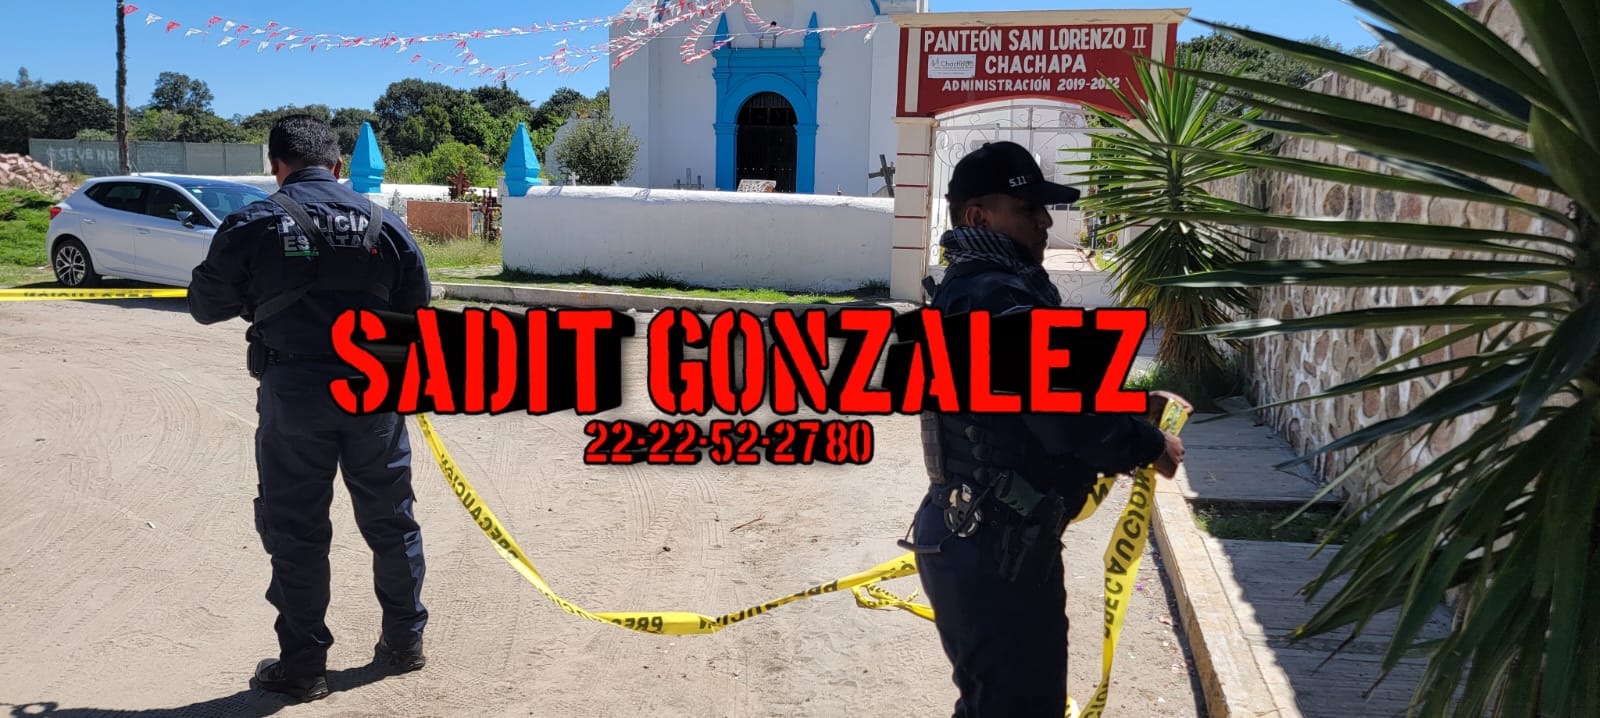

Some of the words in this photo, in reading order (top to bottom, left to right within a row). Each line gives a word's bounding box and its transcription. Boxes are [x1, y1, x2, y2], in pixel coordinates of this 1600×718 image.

[924, 23, 1002, 53] PANTEÓN
[1008, 29, 1043, 51] SAN
[1050, 27, 1126, 50] LORENZO
[985, 53, 1087, 74] CHACHAPA
[941, 76, 1051, 92] ADMINISTRACIÓN
[1057, 77, 1120, 91] 2019-2022
